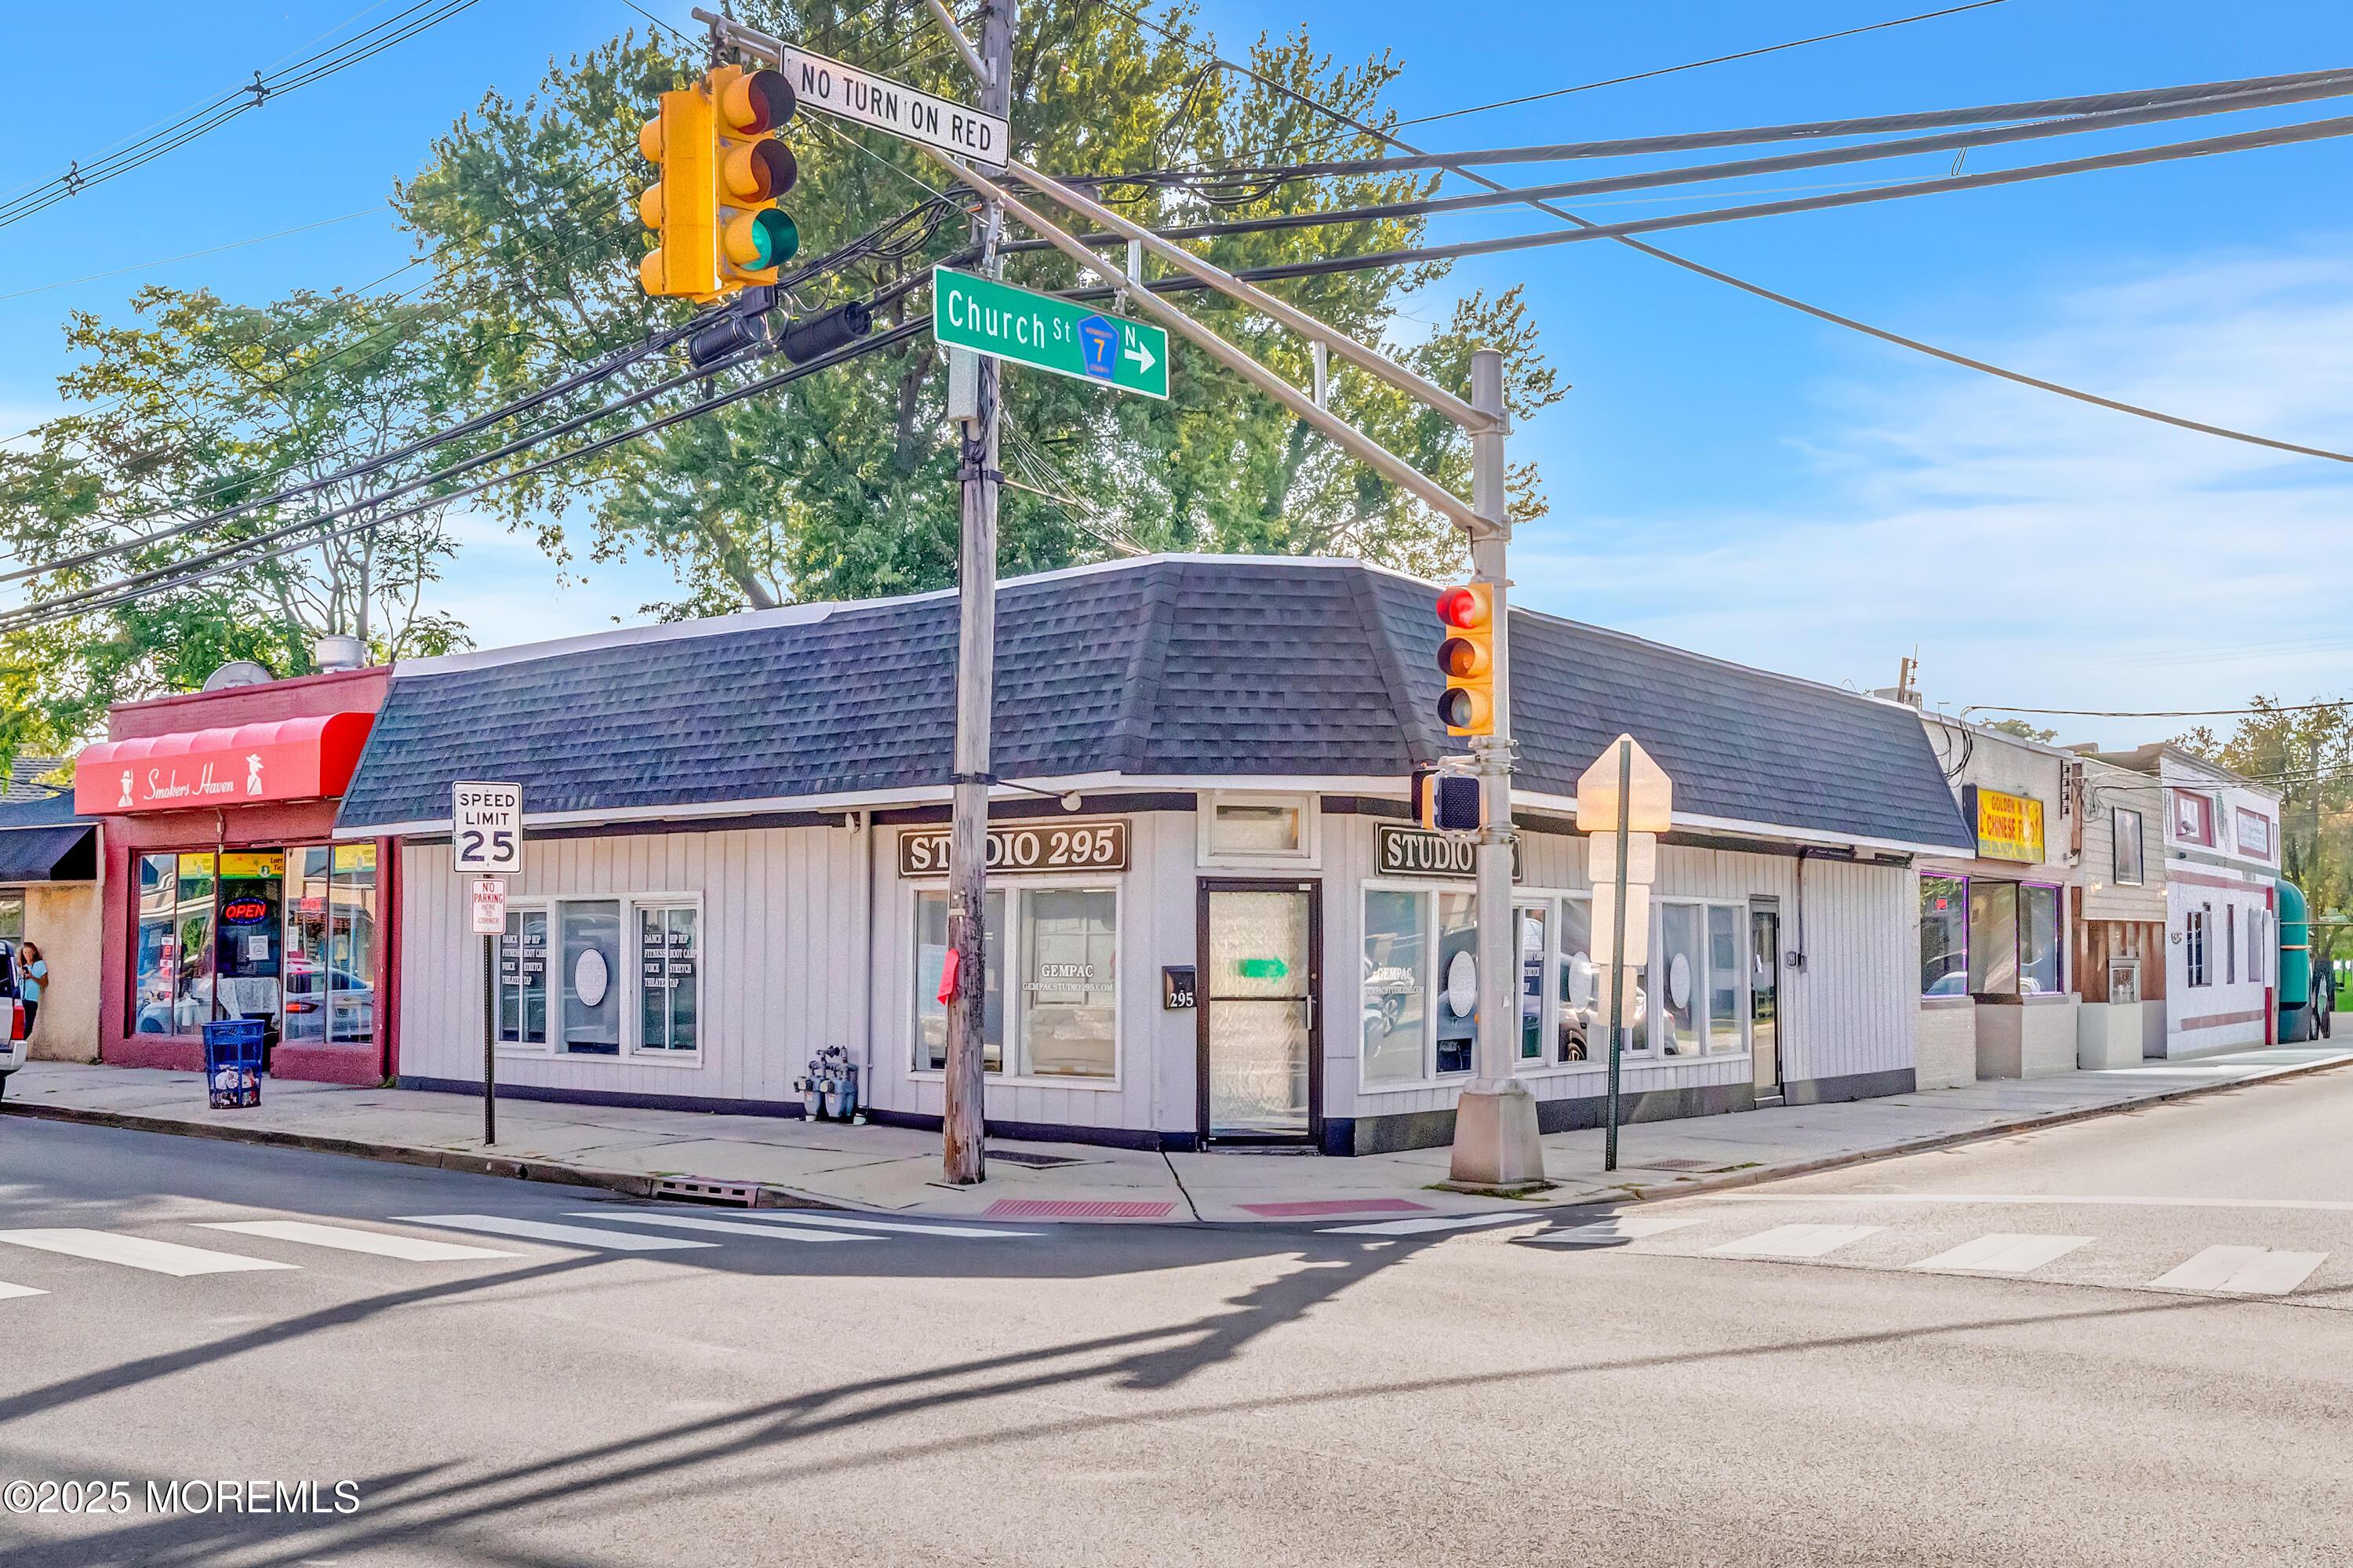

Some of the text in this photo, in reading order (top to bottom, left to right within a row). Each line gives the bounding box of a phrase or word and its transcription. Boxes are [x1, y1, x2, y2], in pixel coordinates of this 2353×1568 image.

[802, 63, 991, 151] NO TURN ON RED
[948, 289, 1071, 349] Church St
[1125, 325, 1136, 348] N
[1093, 338, 1104, 362] 7
[143, 762, 235, 800] Smokers Haven
[460, 793, 515, 807] SPEED
[466, 812, 509, 826] LIMIT
[1987, 813, 2016, 840] CHINESE
[461, 830, 515, 862] 25
[910, 827, 1115, 870] STDIO 295
[1387, 832, 1473, 871] STUDIO
[482, 882, 495, 893] NO
[474, 893, 504, 904] PARKING
[225, 903, 267, 919] OPEN
[644, 933, 663, 944] DANCE
[644, 962, 692, 973] VOICE STRETCH
[1041, 964, 1094, 978] GEMPAC
[1378, 967, 1413, 980] GEMPAC
[1022, 982, 1114, 993] GEMPACSTUDIO295.COM
[1169, 991, 1194, 1007] 295
